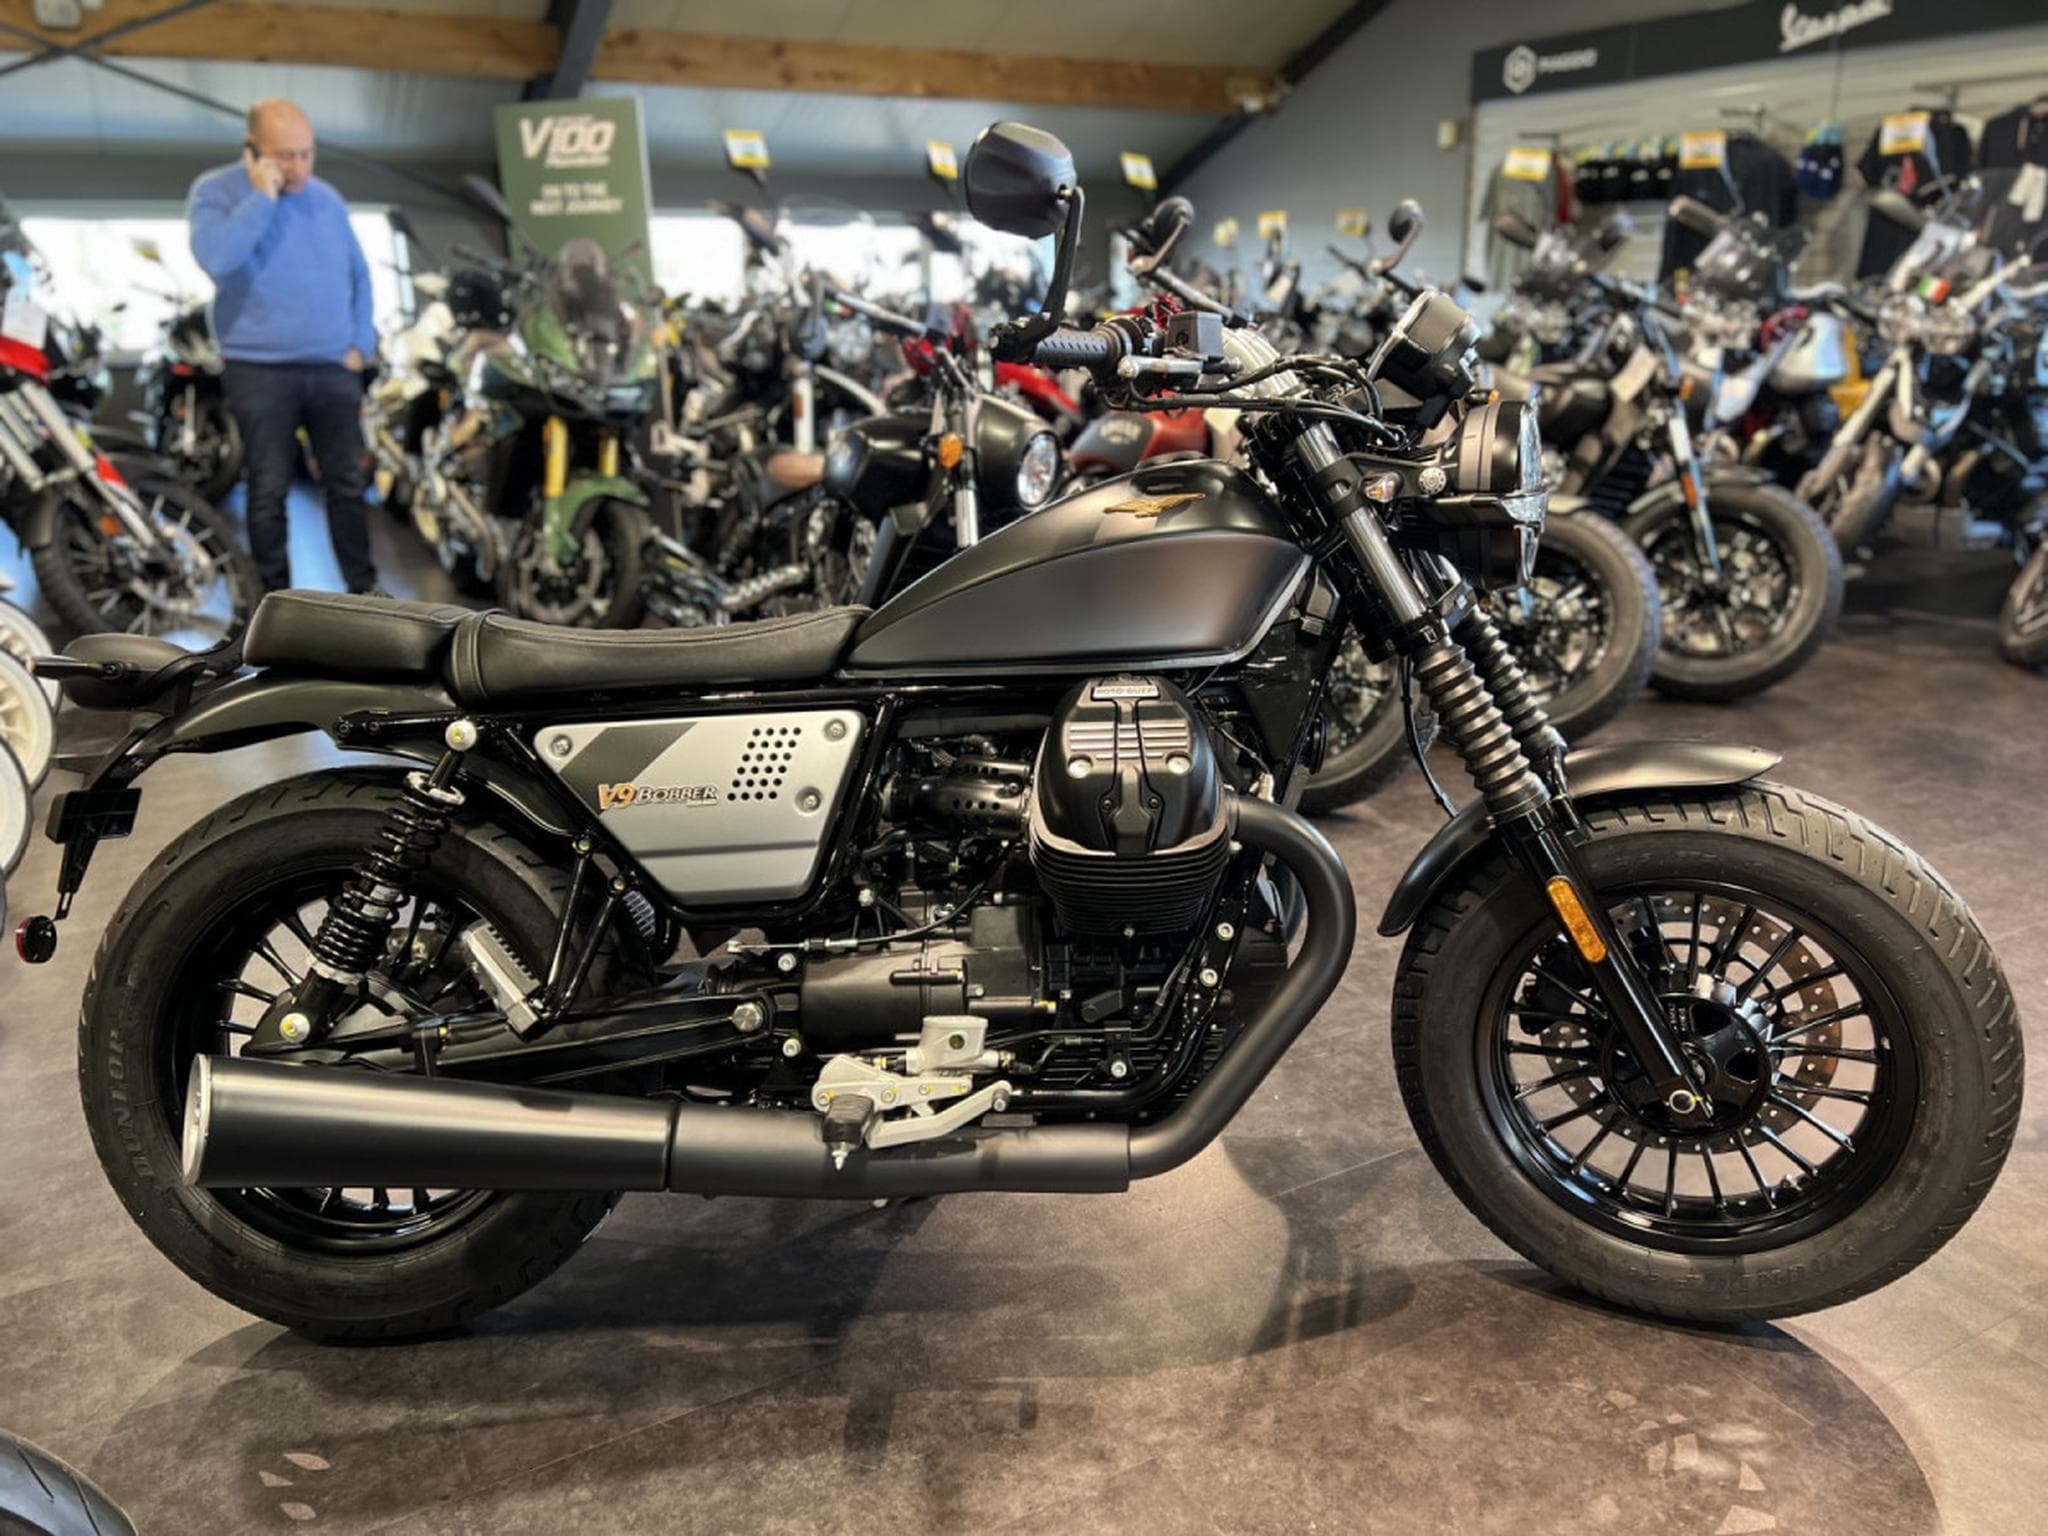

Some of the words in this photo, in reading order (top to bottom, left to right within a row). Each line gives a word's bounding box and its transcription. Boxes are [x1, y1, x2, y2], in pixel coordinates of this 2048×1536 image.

[1780, 0, 1893, 51] Vespa
[519, 117, 616, 161] V100
[598, 783, 638, 810] V9
[637, 786, 718, 806] BOBBER
